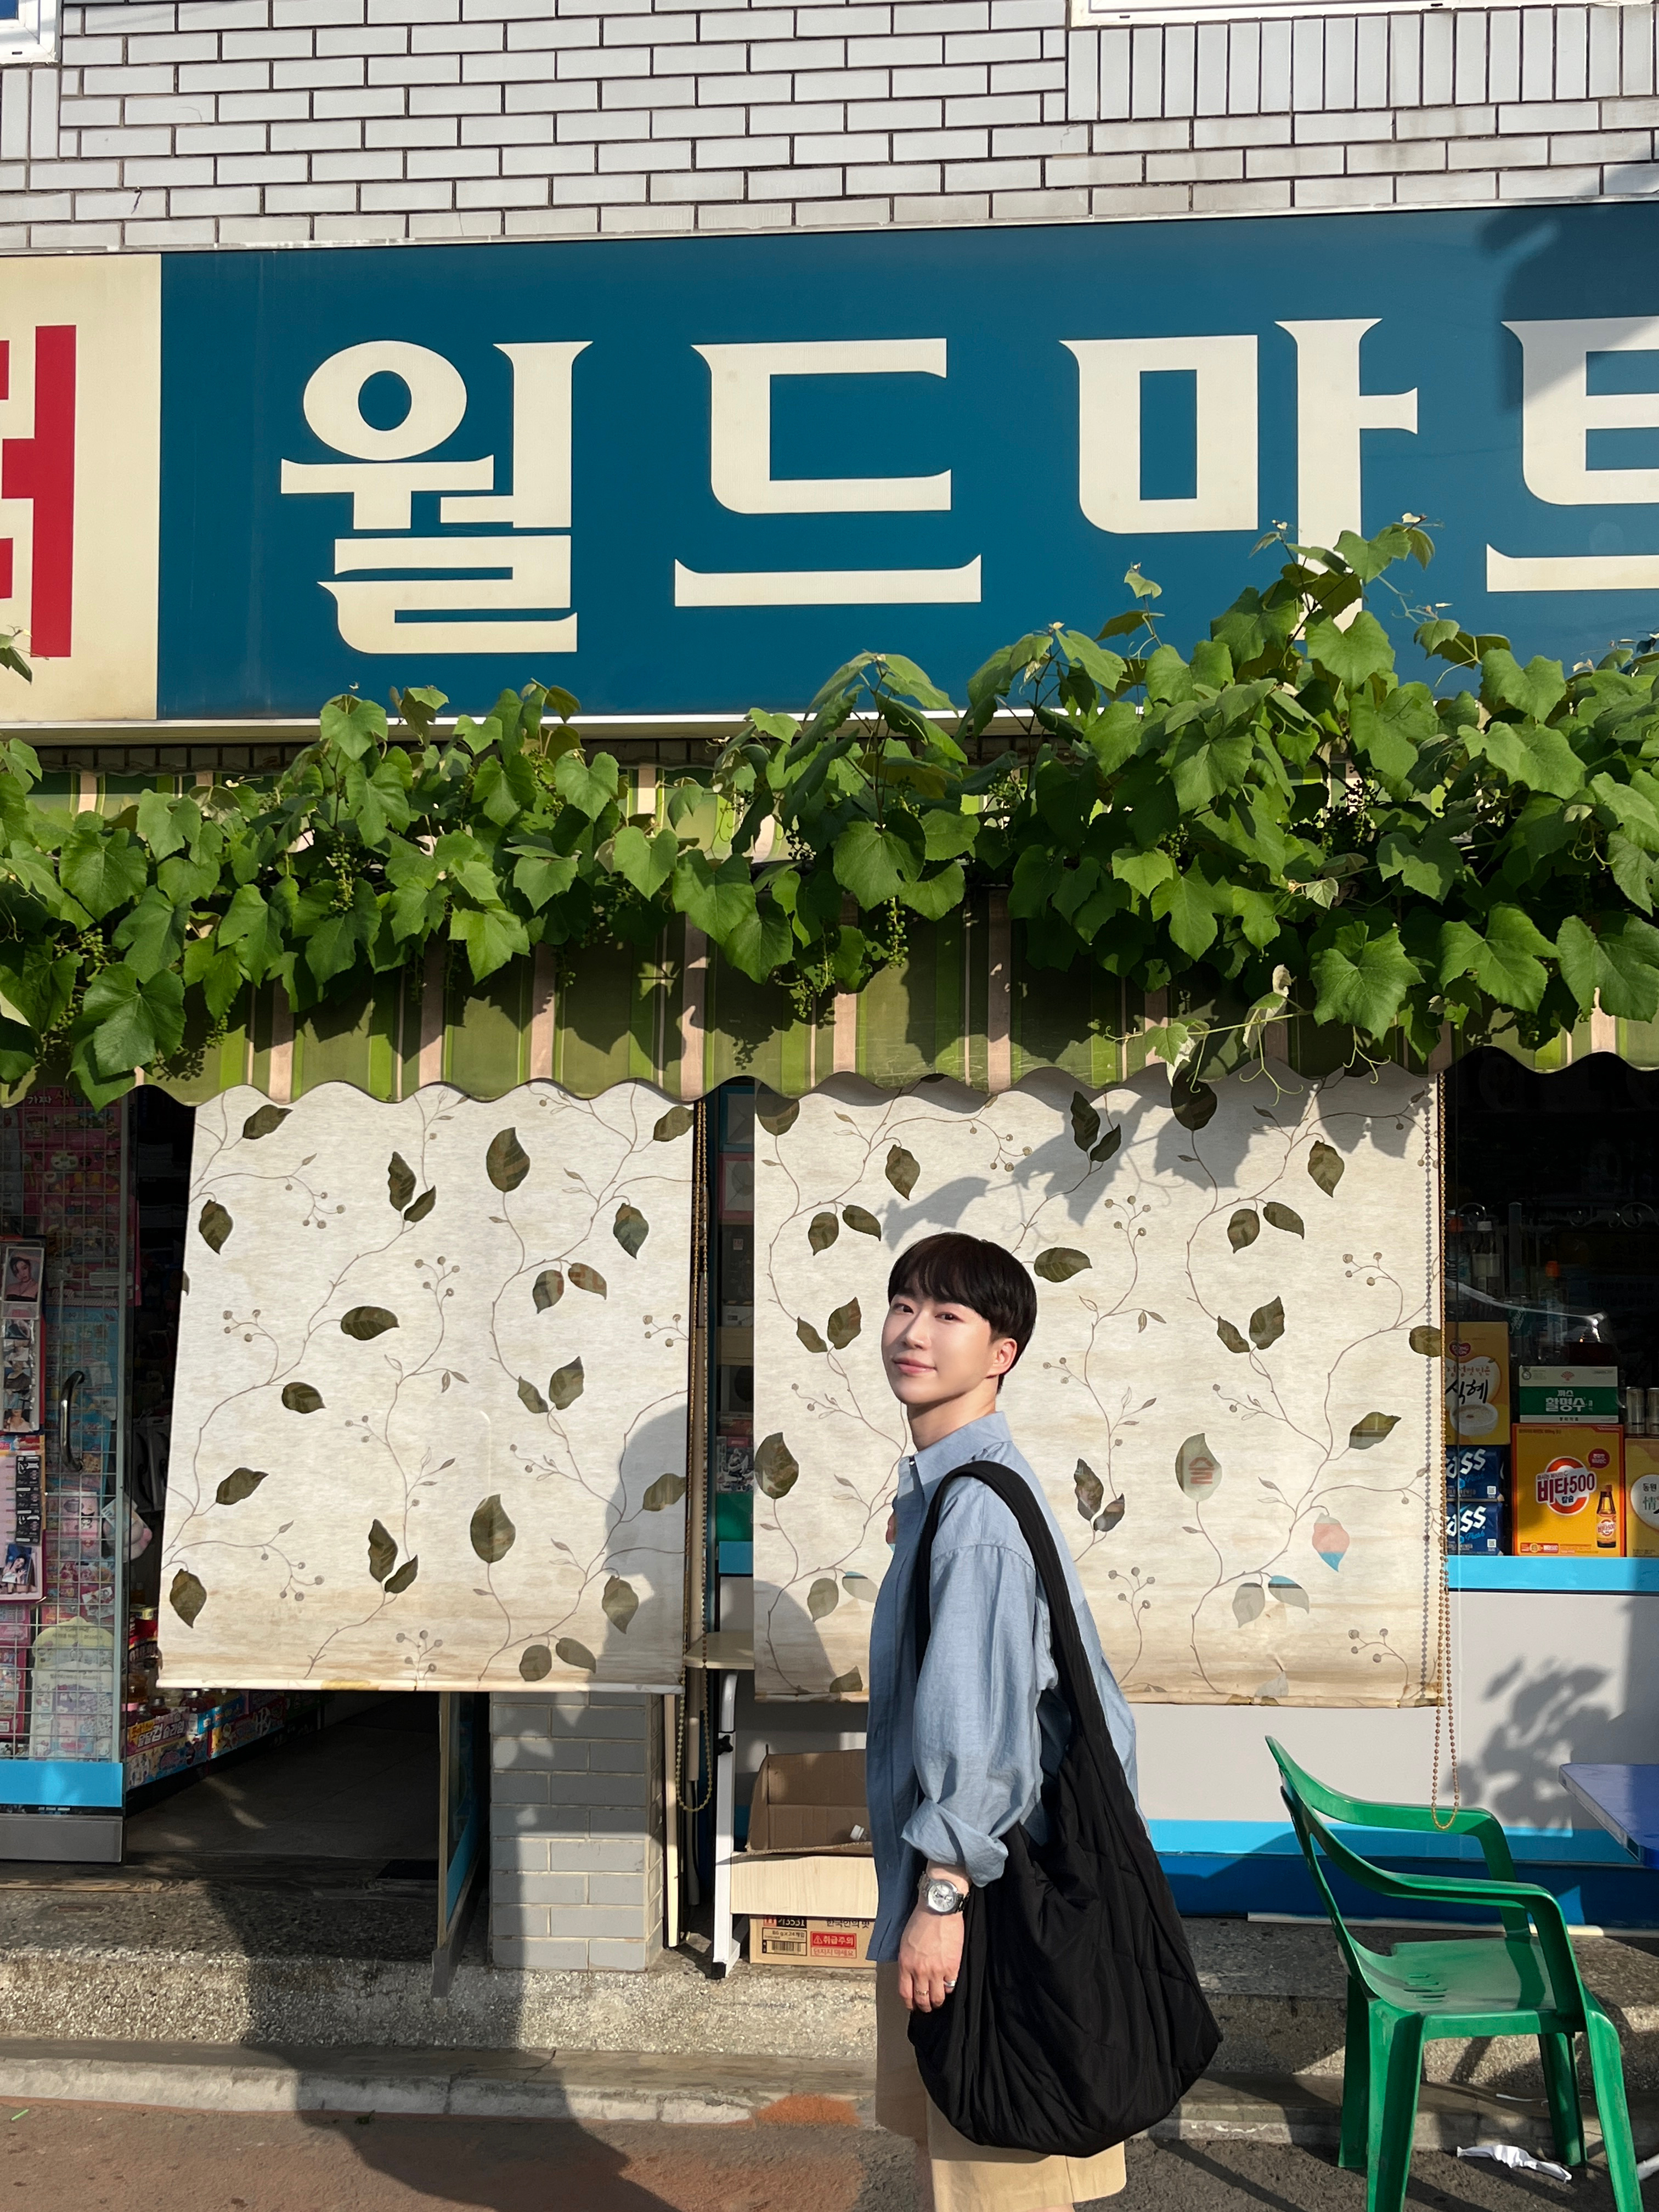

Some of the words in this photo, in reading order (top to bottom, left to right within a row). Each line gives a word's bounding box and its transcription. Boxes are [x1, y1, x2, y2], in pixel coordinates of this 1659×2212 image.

[280, 315, 1659, 654] 월드마트
[27, 1096, 52, 1104] 가짜
[1445, 1379, 1488, 1404] 식혜
[1545, 1397, 1586, 1412] 활명수
[1537, 1473, 1595, 1503] 비타500
[823, 1935, 854, 1945] 취급주의
